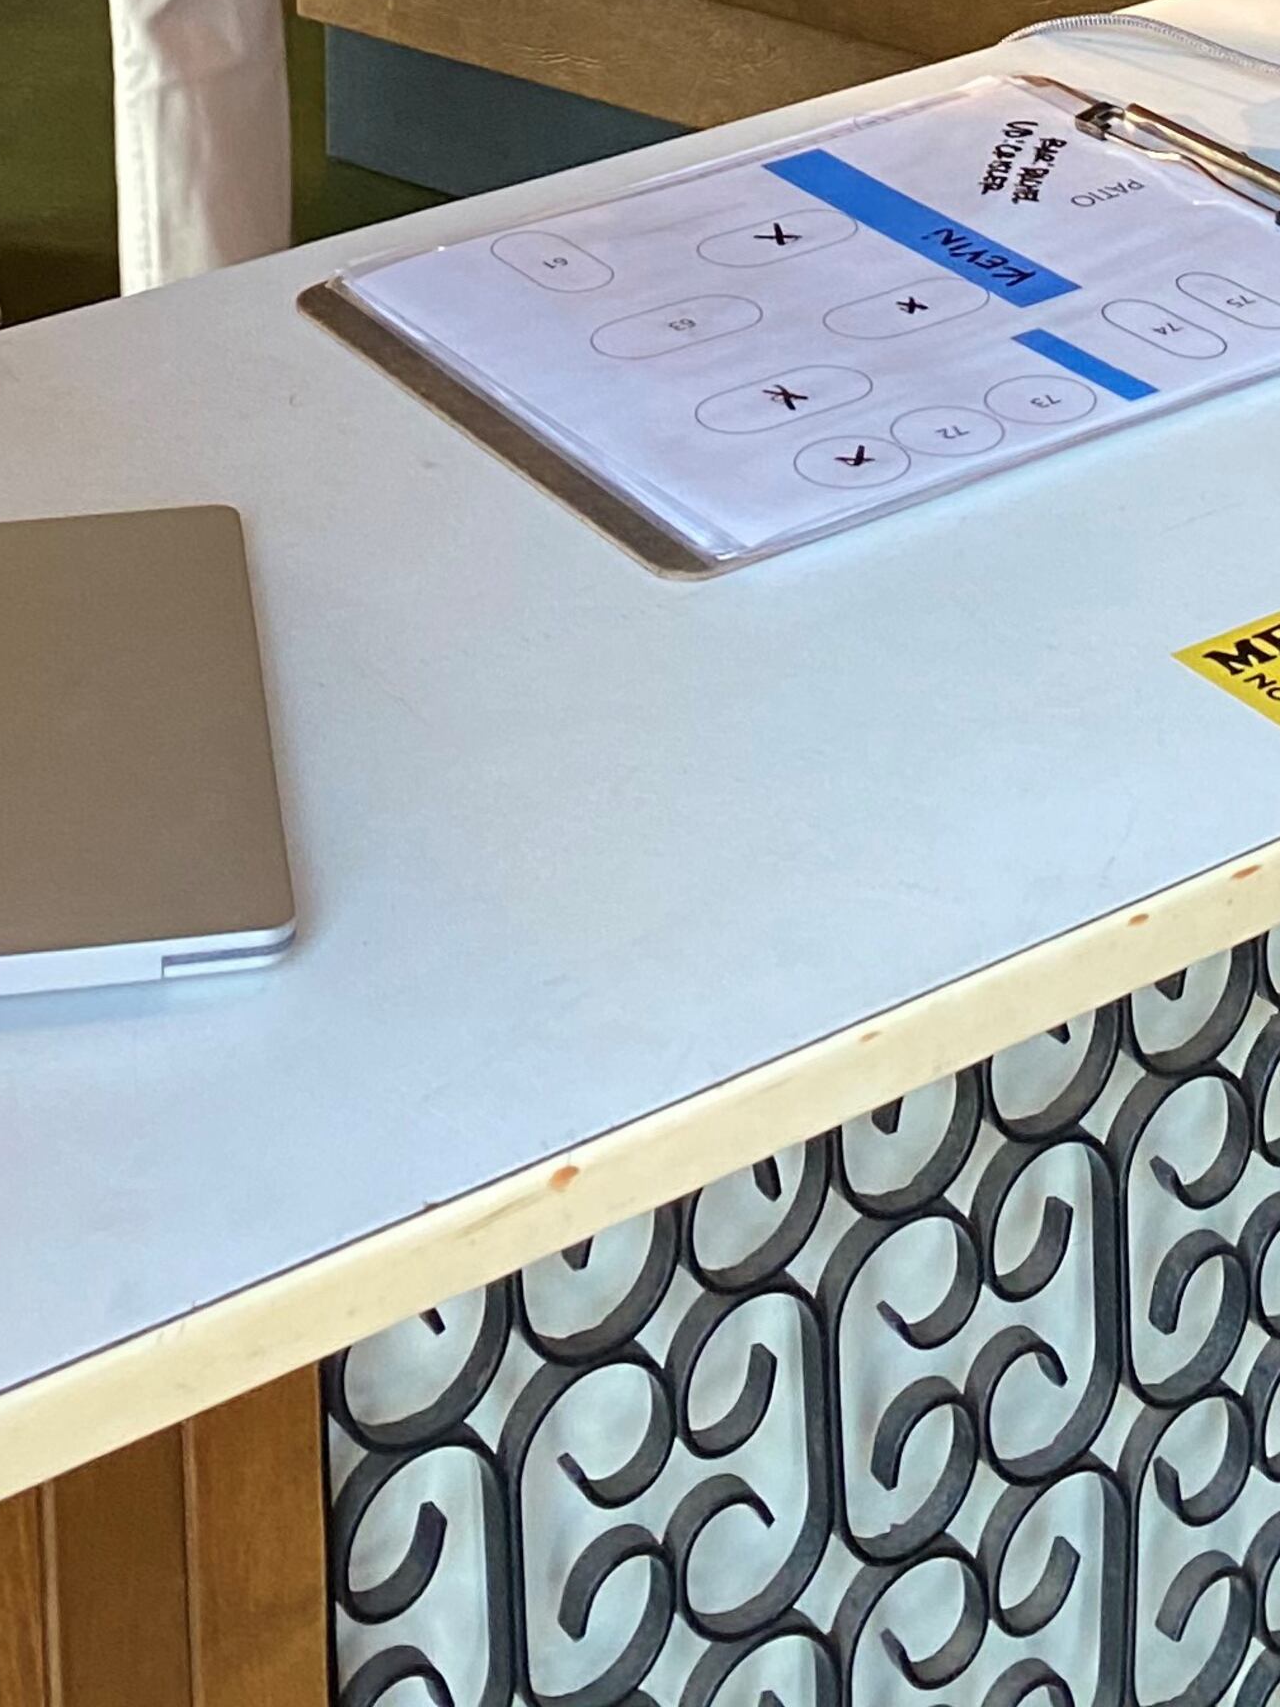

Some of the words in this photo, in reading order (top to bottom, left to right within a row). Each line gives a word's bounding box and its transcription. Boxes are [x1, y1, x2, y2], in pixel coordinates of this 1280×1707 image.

[1070, 178, 1146, 208] PATIO
[542, 256, 569, 270] 61
[920, 227, 1037, 287] KEVIN
[1225, 293, 1257, 310] 75
[667, 317, 697, 332] 63
[1152, 321, 1185, 336] 74
[1029, 393, 1062, 409] 73
[934, 424, 971, 440] 72
